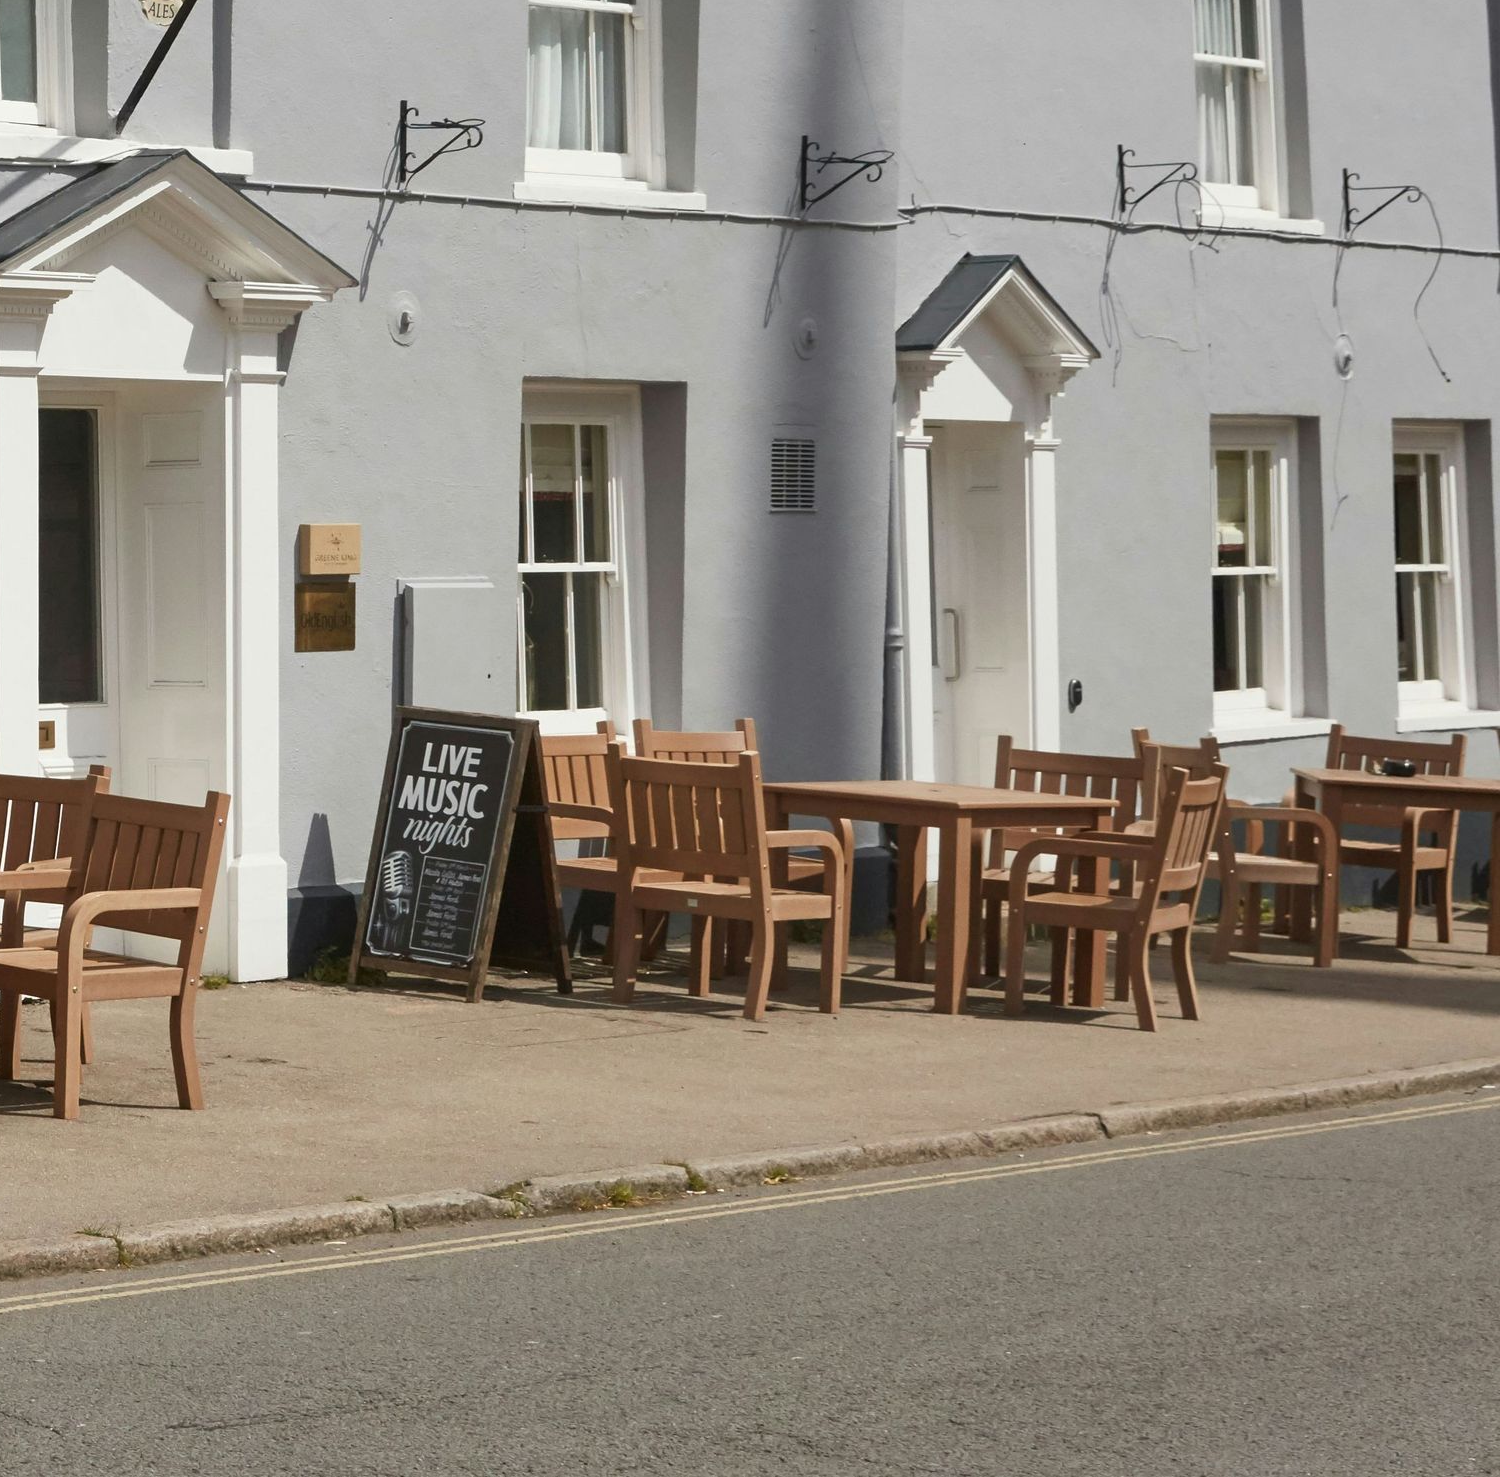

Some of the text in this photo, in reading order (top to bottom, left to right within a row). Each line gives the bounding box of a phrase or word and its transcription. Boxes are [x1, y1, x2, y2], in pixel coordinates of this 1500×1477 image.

[148, 1, 175, 19] ALES
[422, 742, 482, 778] LIVE
[398, 775, 488, 819] MUSIC
[403, 814, 474, 854] nights
